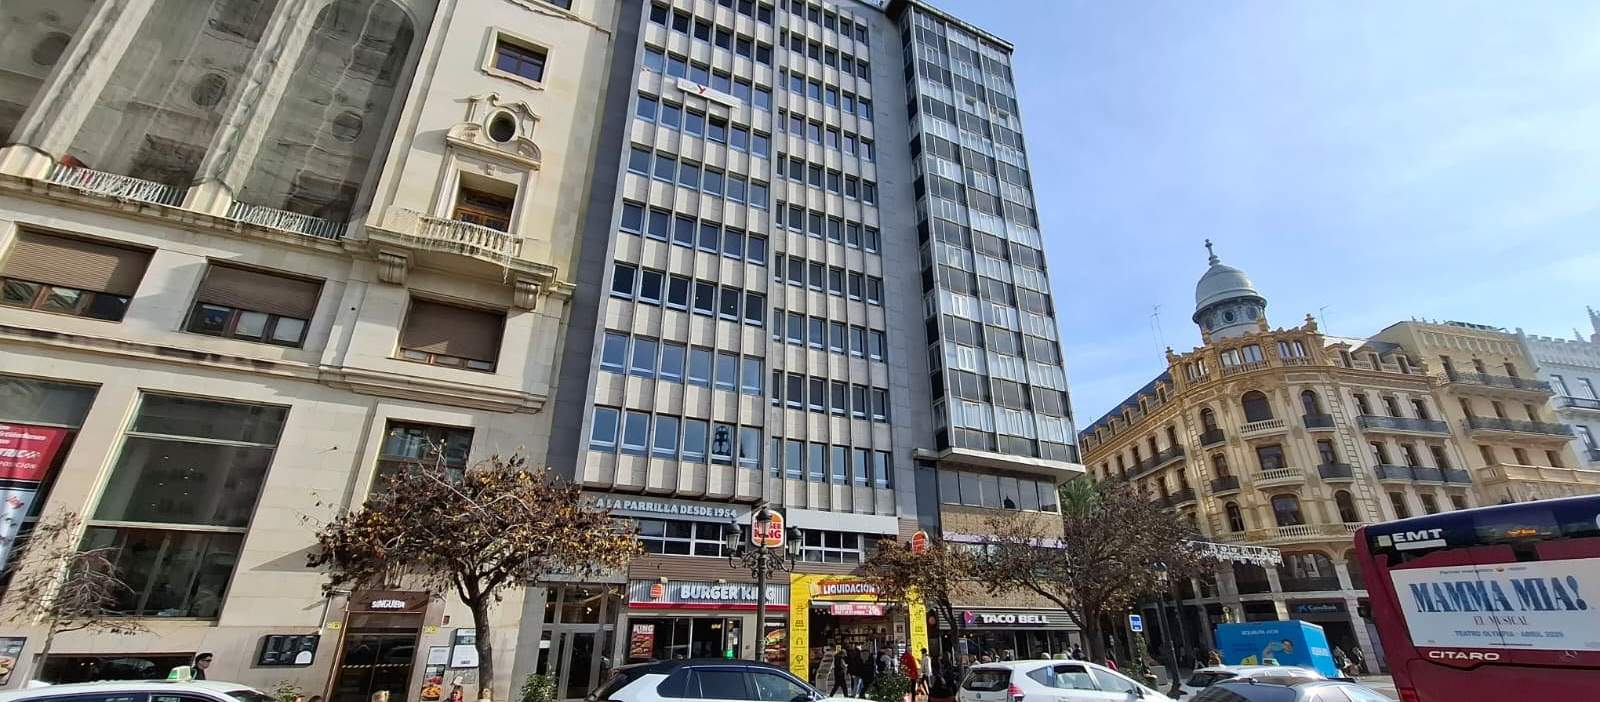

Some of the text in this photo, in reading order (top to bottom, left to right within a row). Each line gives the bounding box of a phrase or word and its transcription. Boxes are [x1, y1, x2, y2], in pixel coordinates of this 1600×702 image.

[596, 498, 738, 518] A LA PARRILLA DESDE 1954
[1392, 528, 1443, 542] EMT
[680, 585, 738, 600] BURGER
[741, 586, 777, 600] KIG
[1408, 575, 1588, 613] MAMMA MIA!
[981, 615, 1051, 624] TACO BELL
[633, 624, 655, 634] KING
[1428, 650, 1500, 661] CITARO
